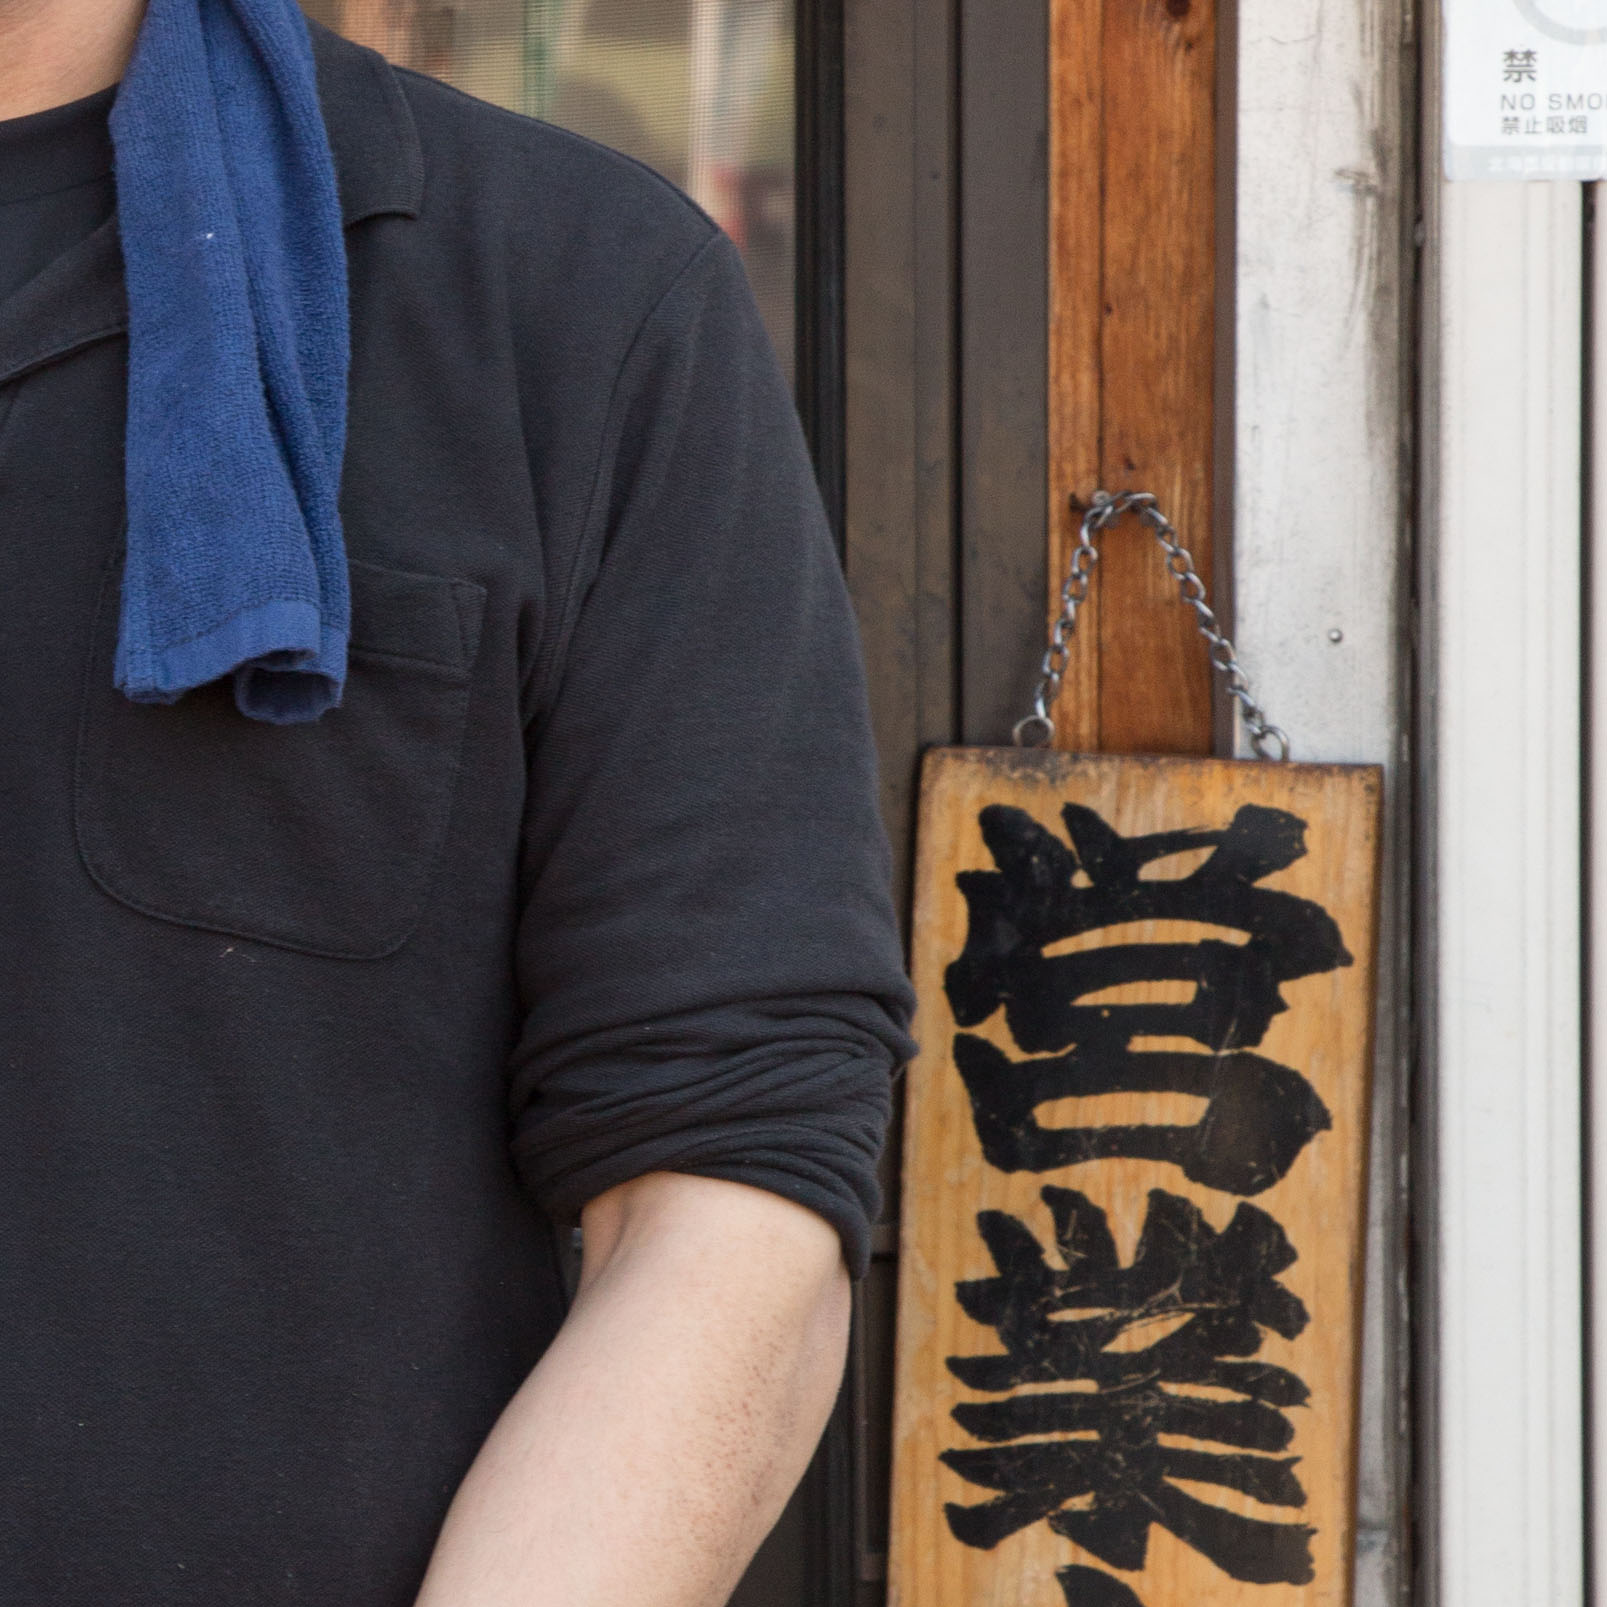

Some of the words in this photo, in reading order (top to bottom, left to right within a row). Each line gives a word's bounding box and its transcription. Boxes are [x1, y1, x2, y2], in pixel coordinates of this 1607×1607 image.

[1502, 49, 1538, 83] 禁
[1501, 93, 1536, 111] NO
[1548, 93, 1607, 111] SMO
